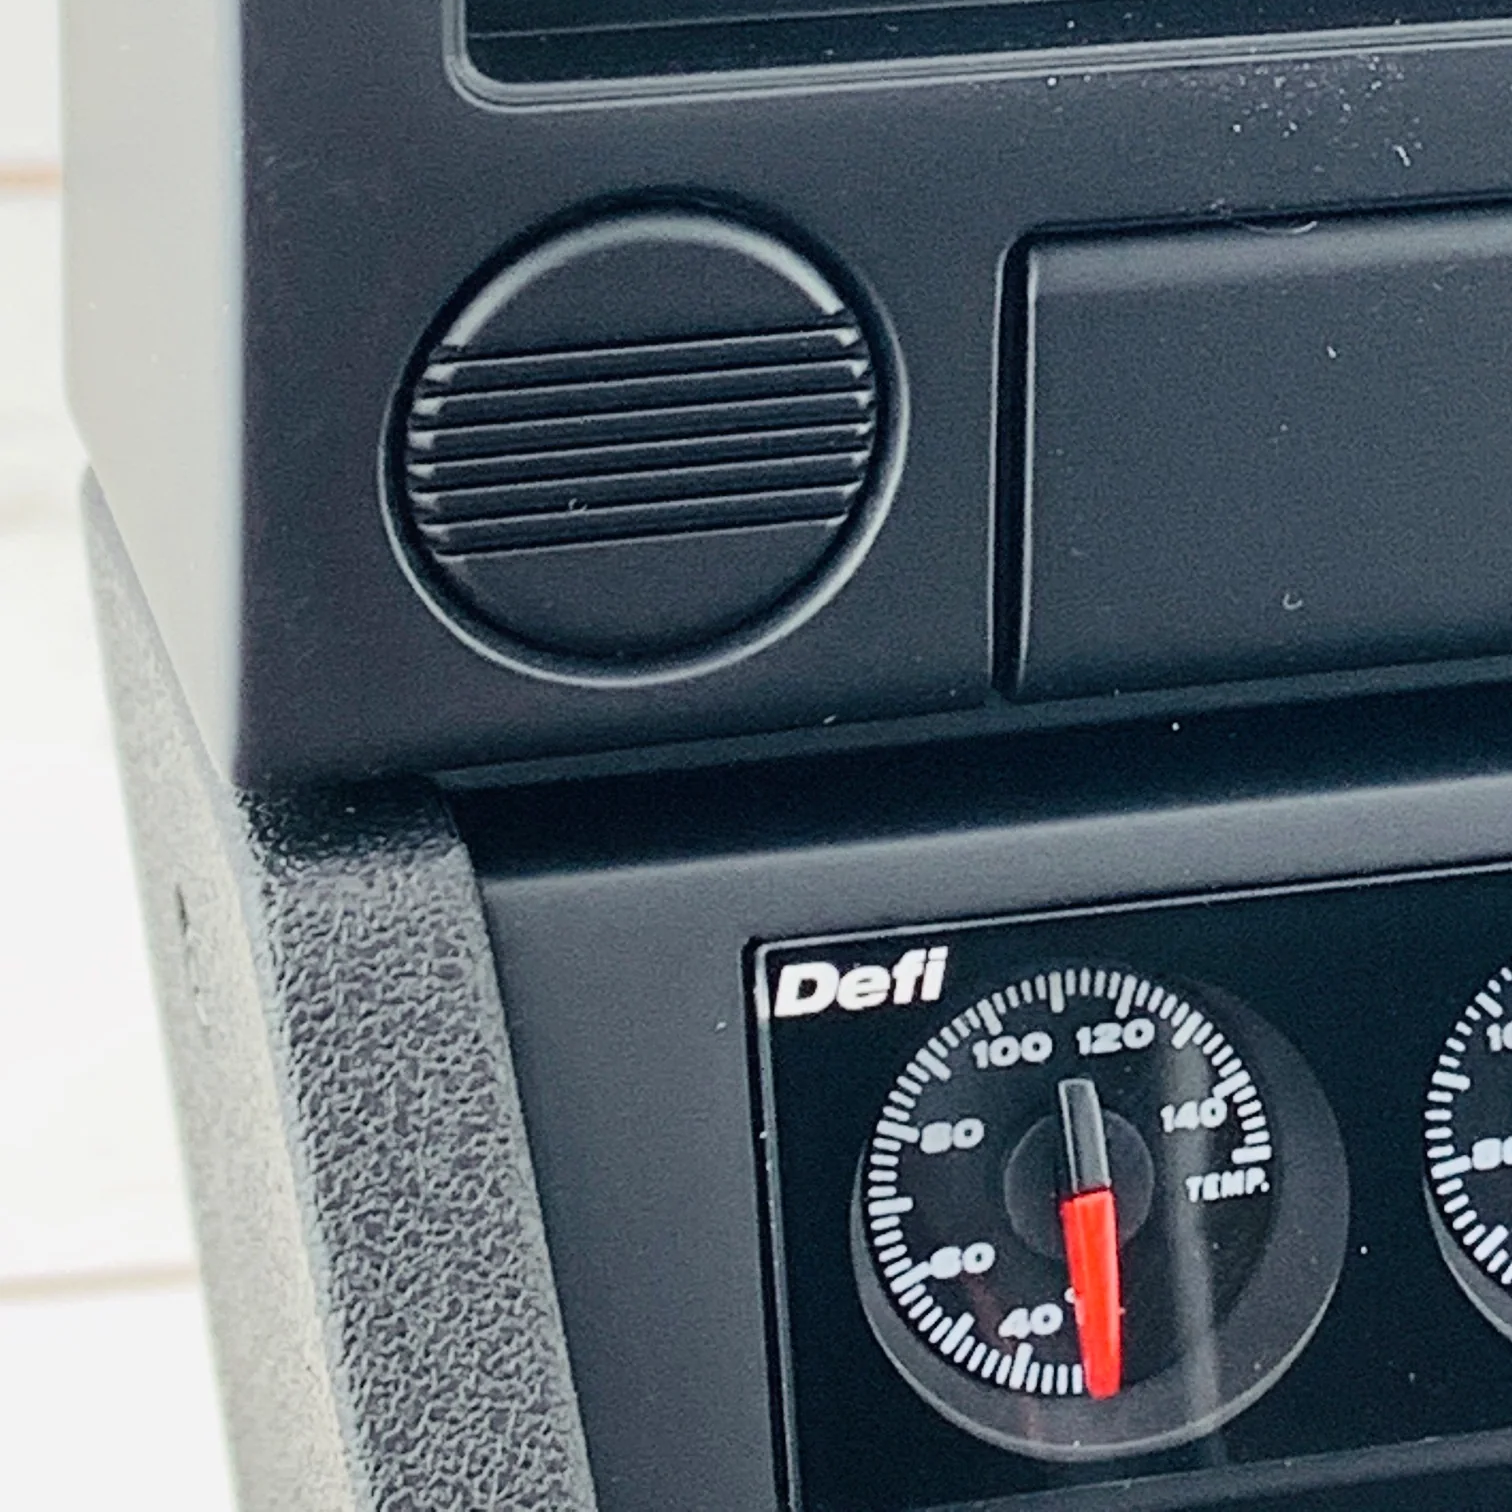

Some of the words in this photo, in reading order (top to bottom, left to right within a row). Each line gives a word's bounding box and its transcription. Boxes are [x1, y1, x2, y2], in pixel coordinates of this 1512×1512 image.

[775, 947, 947, 1017] Defi
[972, 1030, 1054, 1069] 100
[1075, 1017, 1157, 1055] 120
[1159, 1095, 1228, 1133] 140
[998, 1302, 1064, 1339] 40
